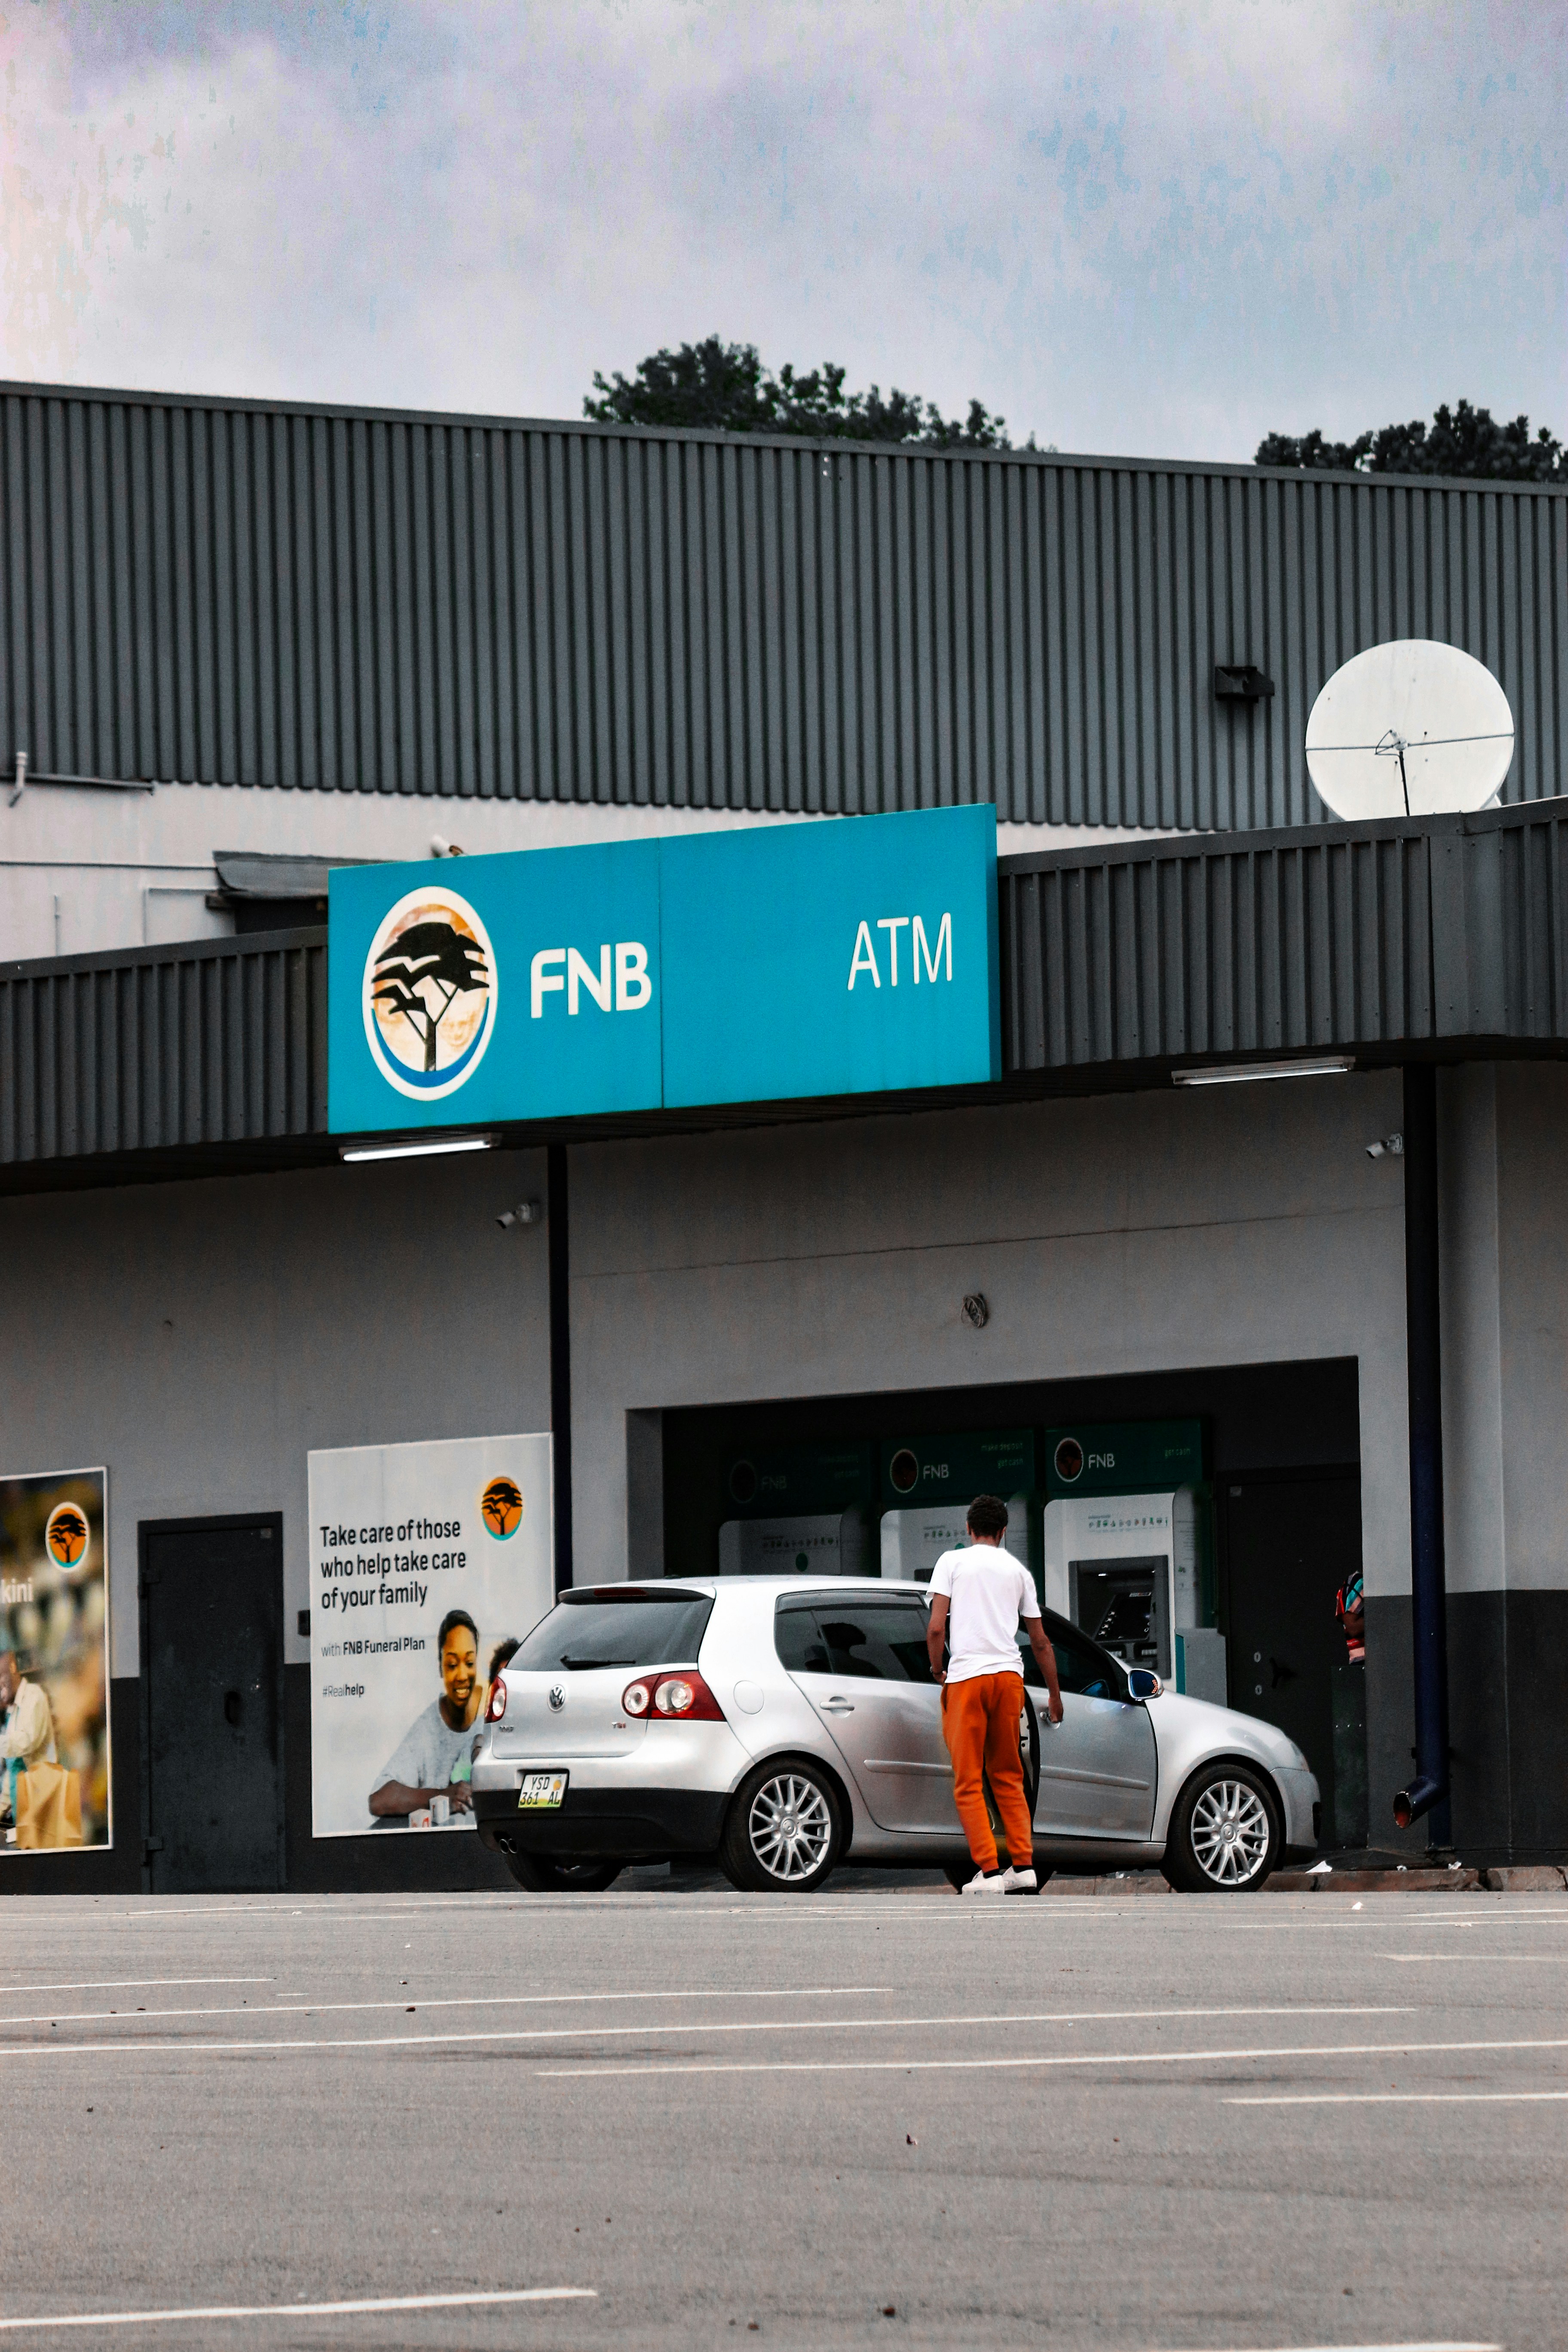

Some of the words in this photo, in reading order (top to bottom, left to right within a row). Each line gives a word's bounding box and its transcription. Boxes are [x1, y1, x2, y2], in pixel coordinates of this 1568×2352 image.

[847, 912, 952, 990] ATM
[531, 942, 652, 1019] FNB
[1088, 1453, 1115, 1469] FNB
[922, 1464, 949, 1480] FNB
[760, 1475, 787, 1491] FNB
[320, 1525, 356, 1547] Take
[360, 1526, 393, 1544] care
[397, 1519, 414, 1541] of
[416, 1518, 460, 1540] those
[321, 1556, 353, 1578] who
[357, 1553, 391, 1579] help
[393, 1550, 428, 1572] take
[432, 1552, 466, 1569] care
[322, 1587, 338, 1609] of
[340, 1589, 376, 1613] your
[379, 1581, 427, 1607] family
[321, 1642, 340, 1657] with
[343, 1640, 362, 1655] FNB
[364, 1638, 401, 1654] Funeral
[403, 1637, 425, 1651] Plan
[322, 1684, 364, 1698] #Realhelp
[532, 1776, 550, 1790] YSD
[520, 1792, 539, 1805] 361
[547, 1791, 560, 1805] AL
